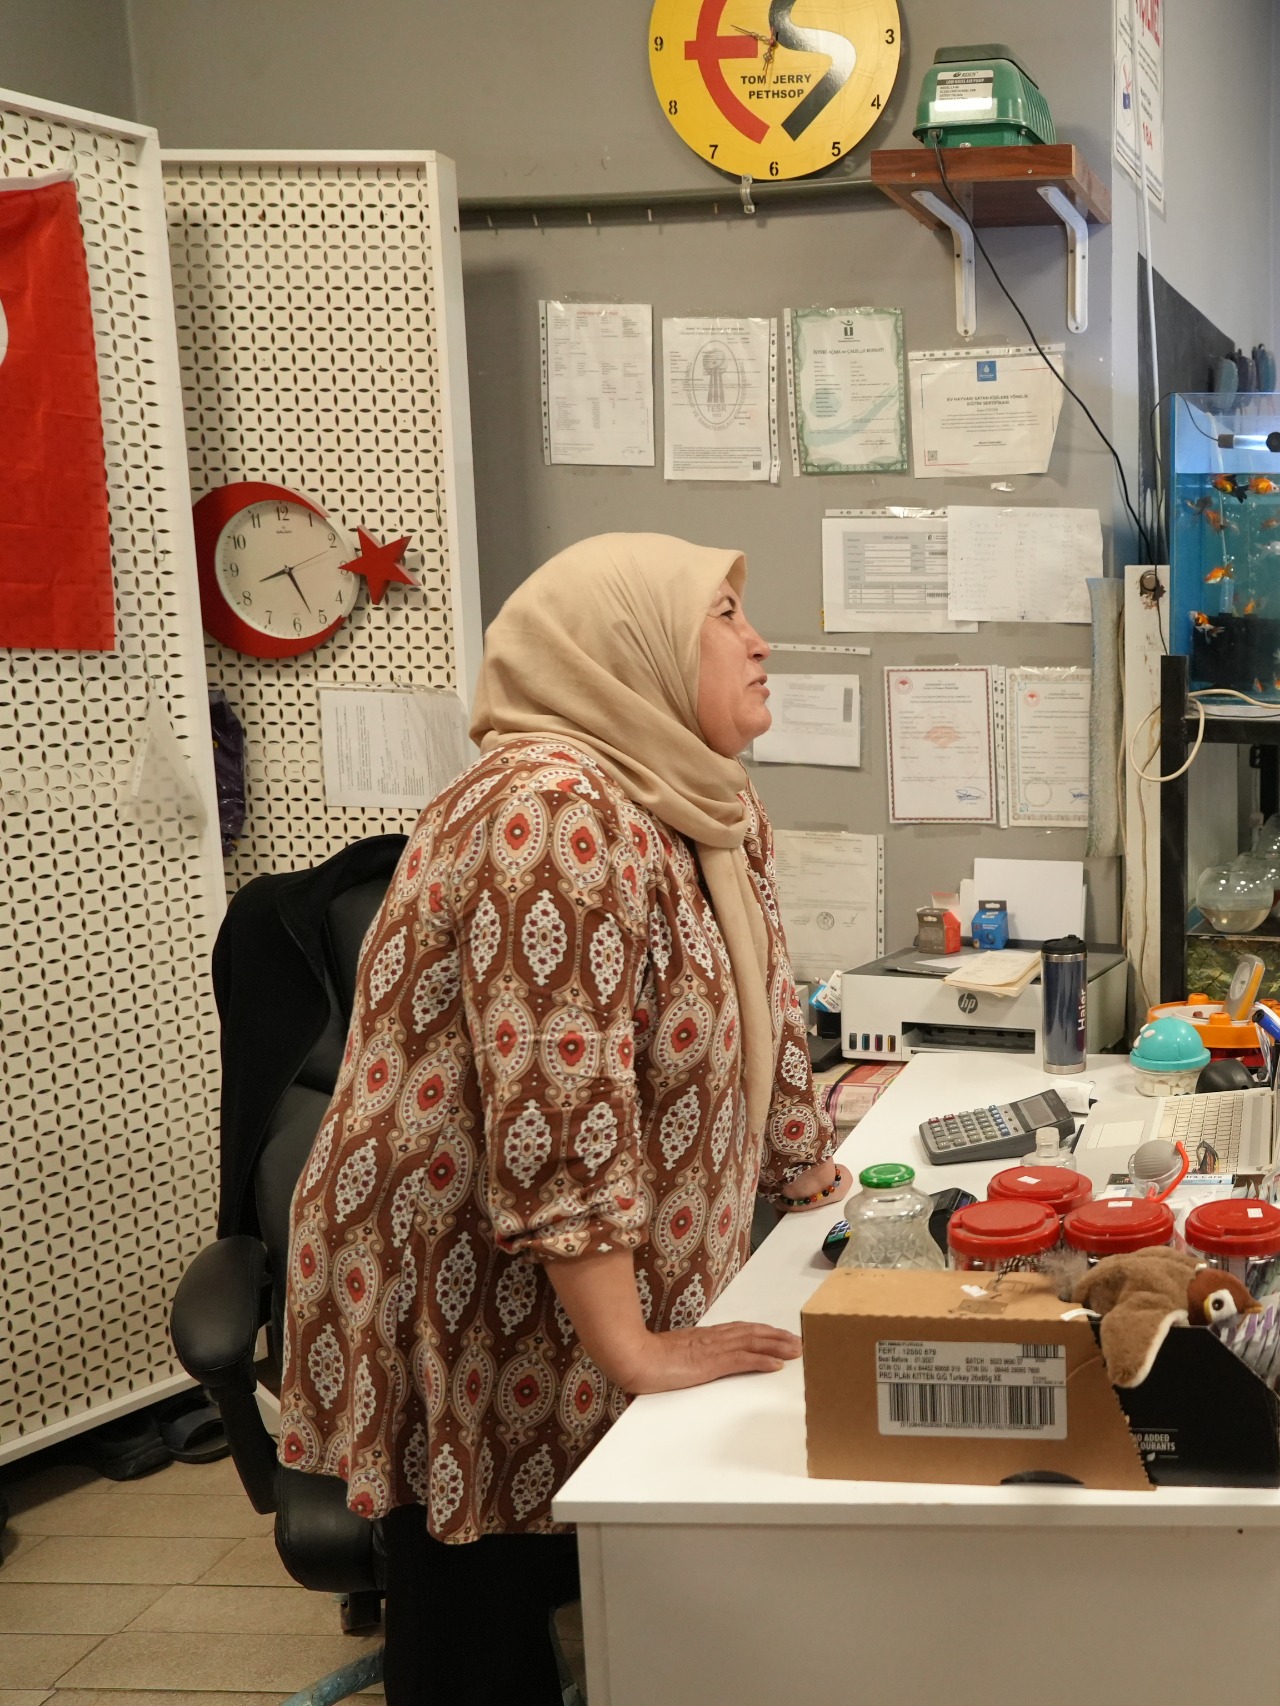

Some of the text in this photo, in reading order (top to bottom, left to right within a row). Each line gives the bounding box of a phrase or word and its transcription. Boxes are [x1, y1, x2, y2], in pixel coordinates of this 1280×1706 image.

[654, 36, 664, 52] 9
[885, 28, 895, 45] 3
[741, 74, 812, 85] TOM JERRY
[748, 89, 805, 100] PETHSOP
[870, 94, 882, 110] 4
[668, 100, 678, 116] 8
[709, 145, 719, 160] 7
[831, 142, 841, 157] 5
[769, 161, 779, 177] 6
[250, 512, 261, 529] 11
[276, 505, 290, 521] 12
[308, 512, 313, 527] 1
[232, 534, 247, 550] 10
[327, 533, 337, 549] 2
[229, 562, 239, 577] 9
[242, 590, 252, 606] 8
[335, 589, 343, 604] 4
[265, 610, 273, 625] 7
[293, 616, 302, 632] 6
[318, 609, 327, 624] 5
[960, 993, 977, 1014] hp
[1077, 989, 1088, 1031] Haier
[1144, 1433, 1170, 1442] ADDED
